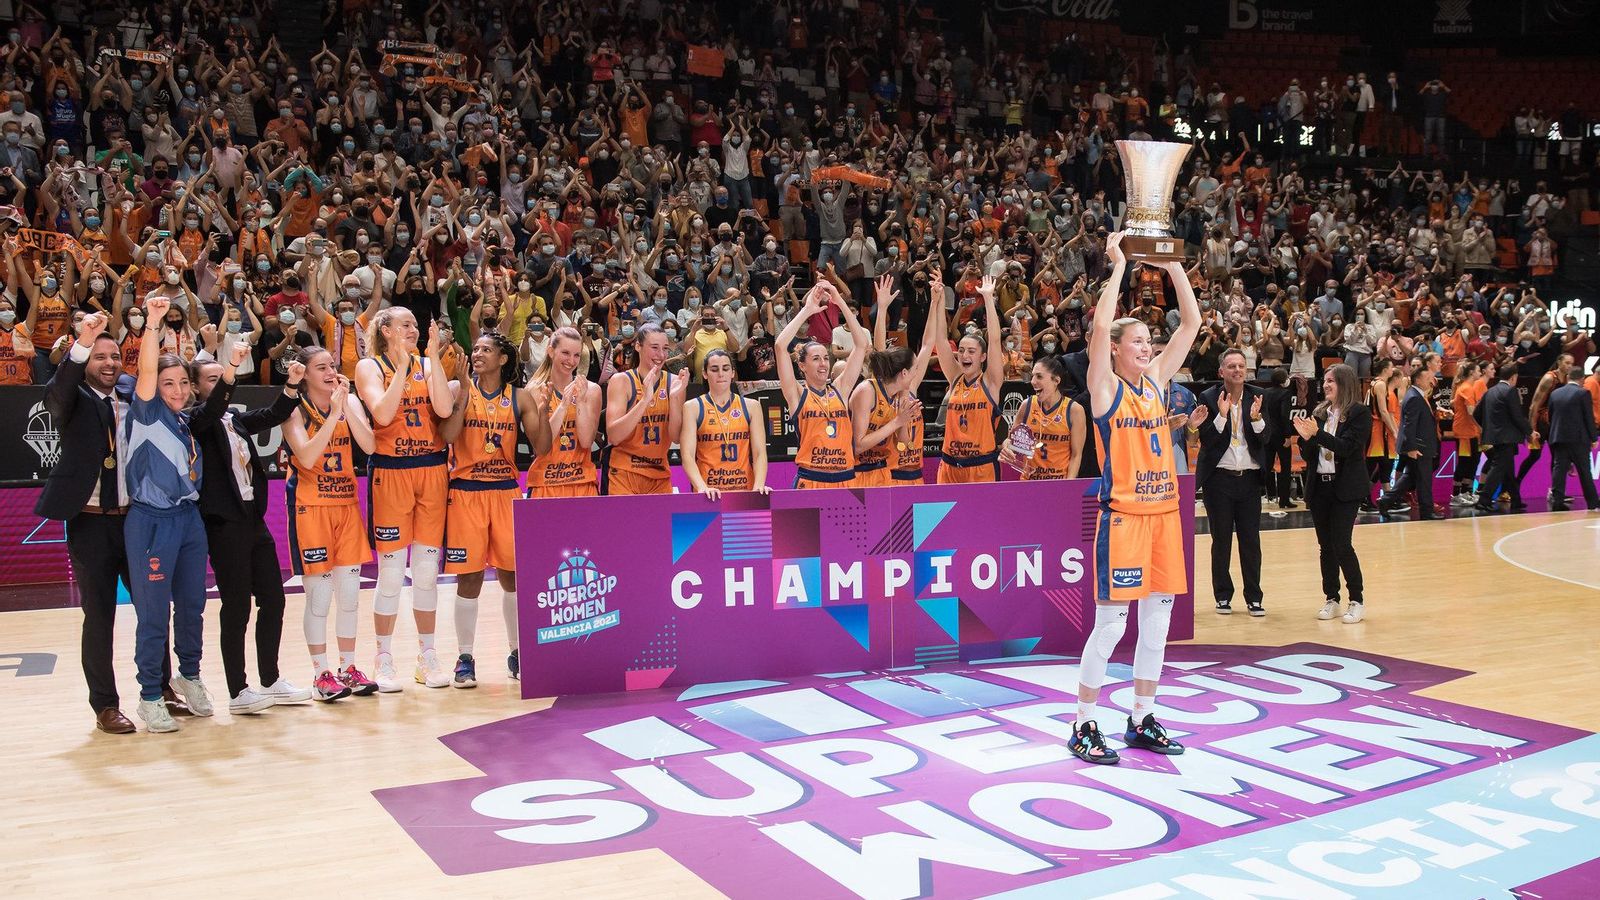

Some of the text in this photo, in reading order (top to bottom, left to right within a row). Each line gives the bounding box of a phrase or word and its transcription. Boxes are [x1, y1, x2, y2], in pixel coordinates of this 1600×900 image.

[1262, 8, 1313, 20] the travel
[1262, 20, 1296, 31] brand
[48, 323, 55, 334] 5
[5, 364, 17, 376] 10
[1151, 433, 1161, 457] 4
[707, 475, 748, 486] Esfuerzo
[708, 468, 740, 477] Cultura
[671, 548, 1085, 610] CHAMPIONS
[1114, 569, 1142, 577] PULEVA
[537, 575, 618, 609] SUPERCUP
[551, 596, 606, 626] WOMEN
[540, 613, 618, 640] VALENCIA 2021
[470, 653, 1397, 845] SUPERCUP
[757, 704, 1530, 900] WOMEN
